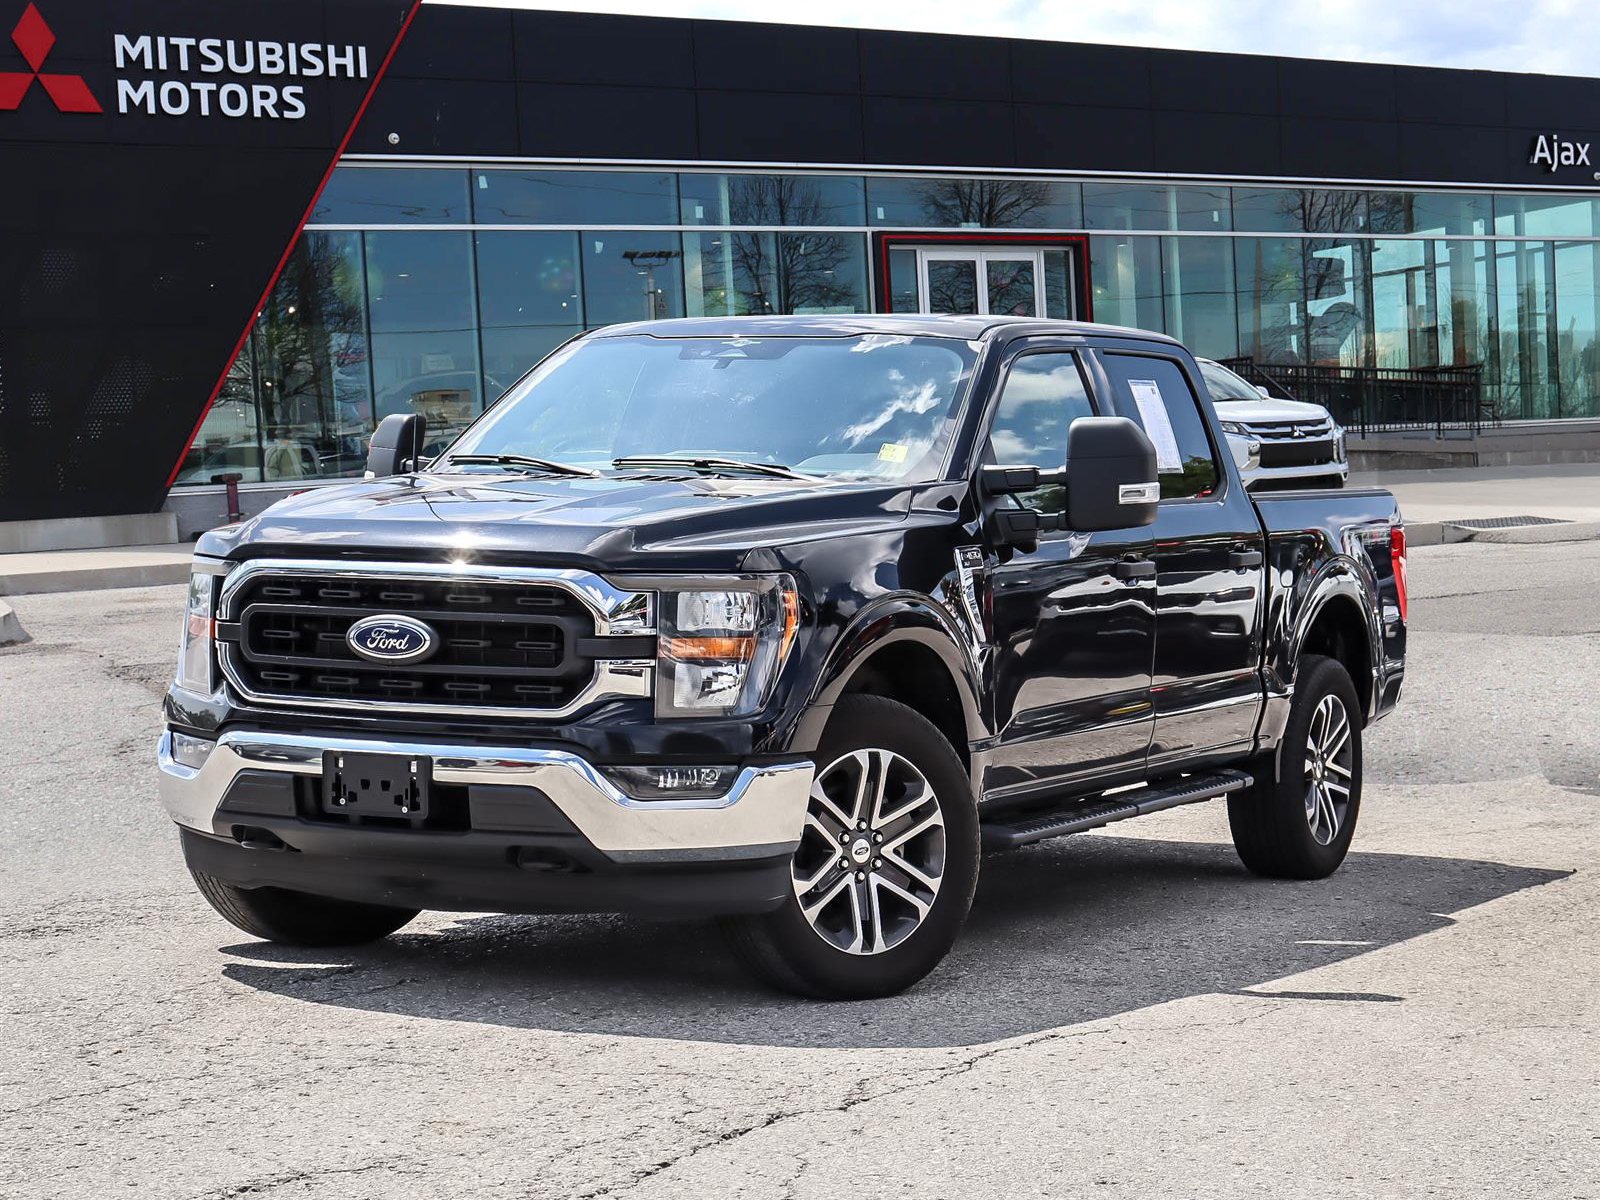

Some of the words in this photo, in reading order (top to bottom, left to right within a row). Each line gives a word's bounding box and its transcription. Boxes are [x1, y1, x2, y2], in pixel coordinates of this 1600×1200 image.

[114, 33, 368, 78] MITSUBISHI
[117, 79, 306, 119] MOTORS
[1533, 134, 1591, 173] Ajax
[366, 627, 410, 650] Ford
